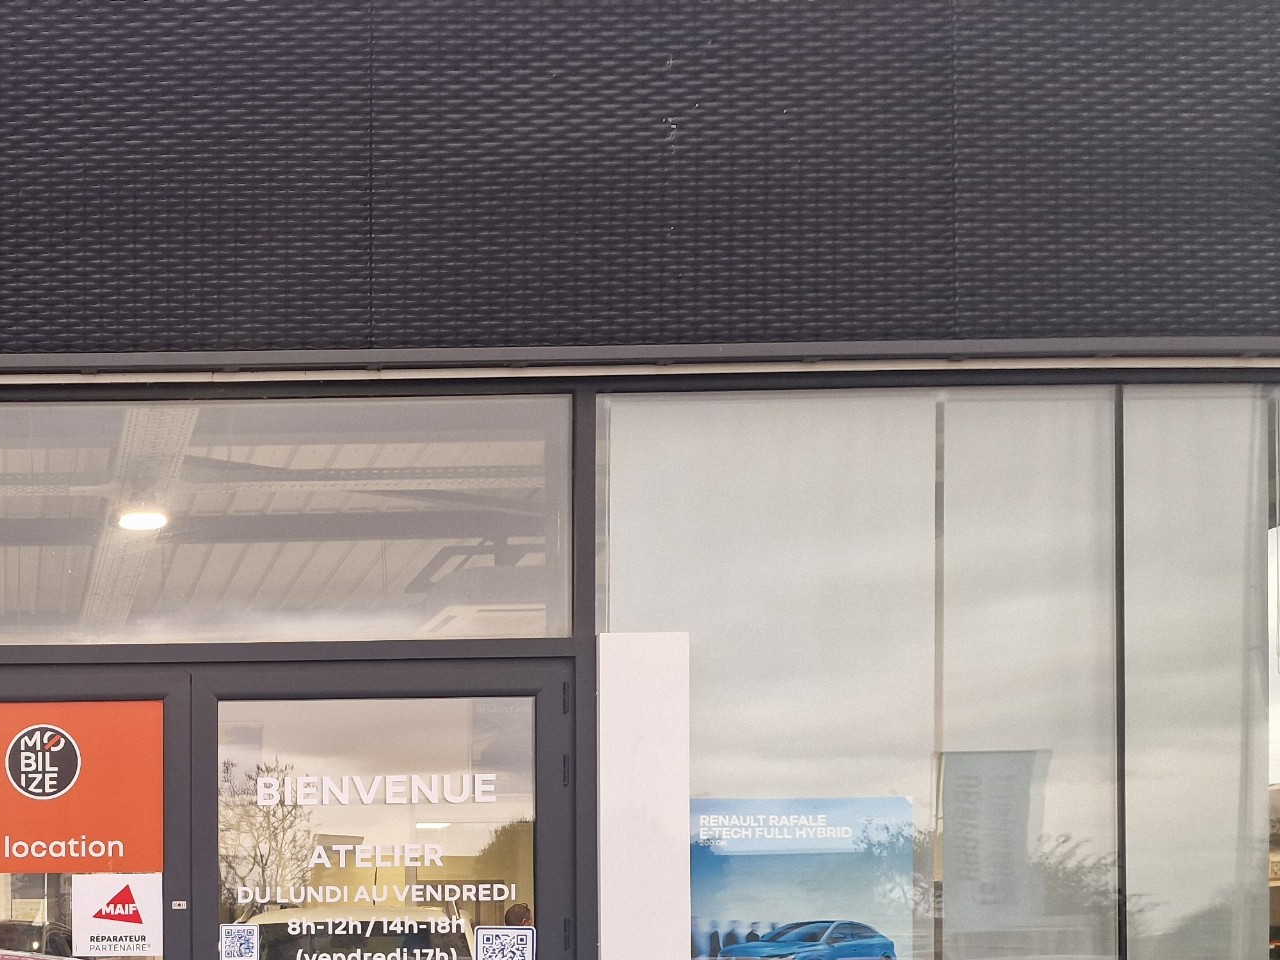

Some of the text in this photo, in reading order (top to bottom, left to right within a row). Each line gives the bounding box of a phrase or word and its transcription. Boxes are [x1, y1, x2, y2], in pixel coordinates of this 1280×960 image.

[256, 773, 497, 806] BIENVENUE
[699, 814, 827, 827] RENAULT RAFALE
[699, 827, 852, 839] E-TECH FULL HYBRID
[4, 835, 124, 858] location
[308, 844, 444, 868] ATELIER
[237, 883, 516, 904] DU LUNDI AU VENDREDI
[101, 903, 138, 915] MAIF
[287, 916, 465, 938] 8h-12h / 14h-18h
[89, 934, 147, 943] RÉPARATEUR
